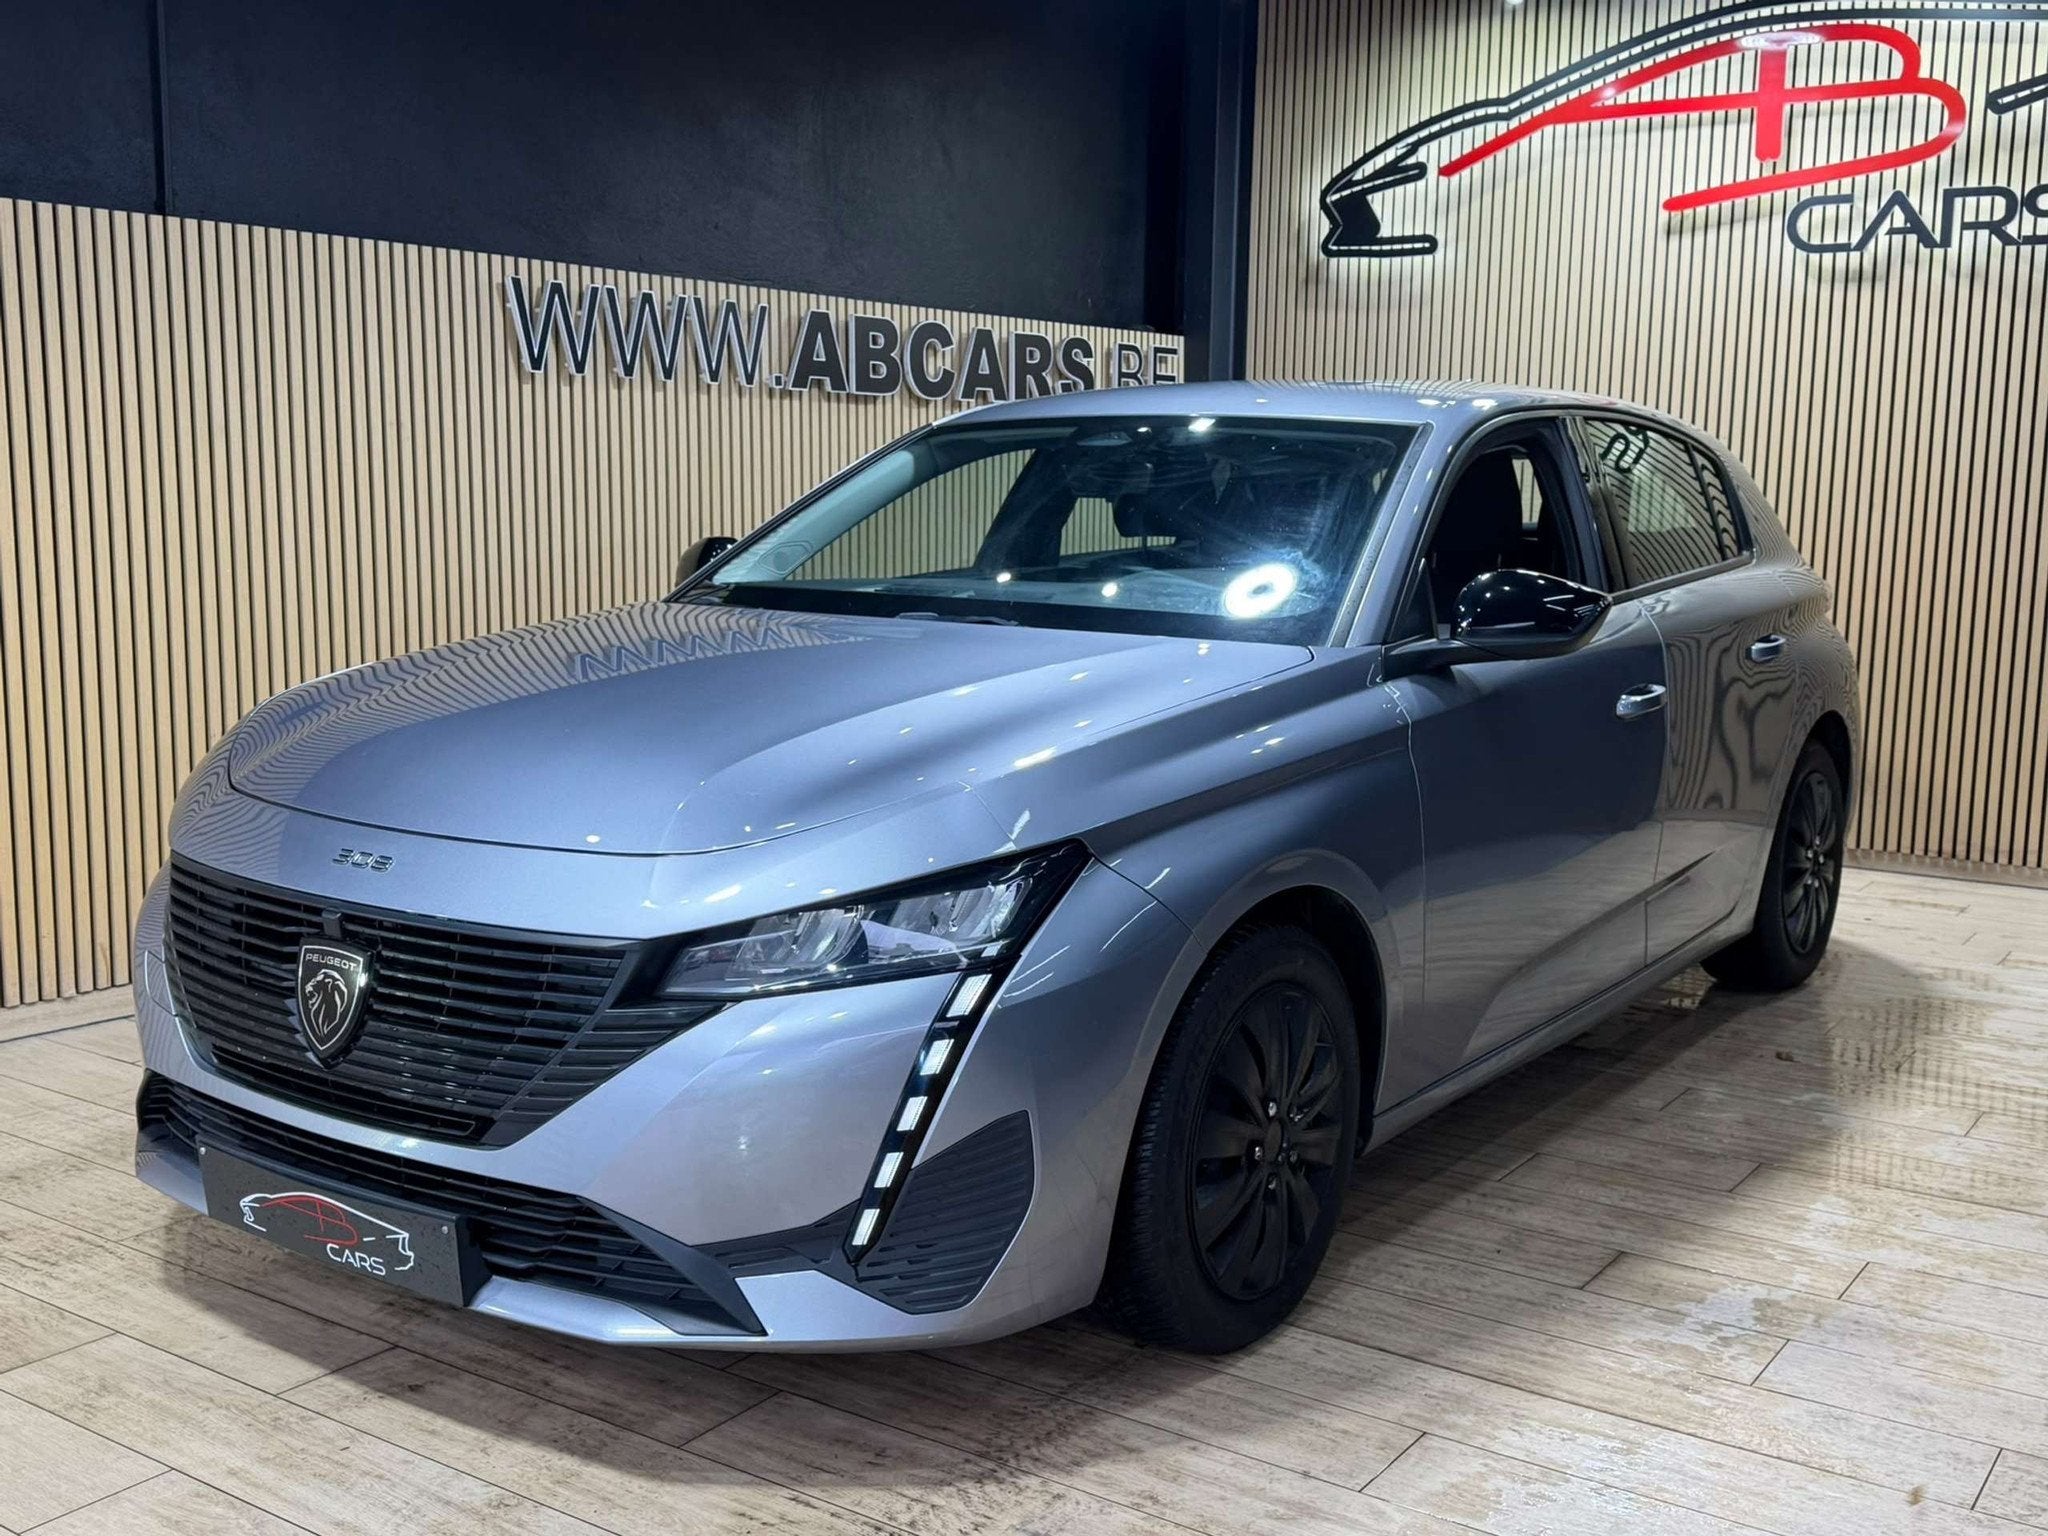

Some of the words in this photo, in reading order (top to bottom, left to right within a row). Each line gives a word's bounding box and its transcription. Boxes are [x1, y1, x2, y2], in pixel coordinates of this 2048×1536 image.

[505, 275, 1181, 402] WWW.ABCARSBE
[333, 848, 394, 873] 308
[305, 952, 358, 972] PEUGEOT
[326, 1243, 386, 1276] CARS
